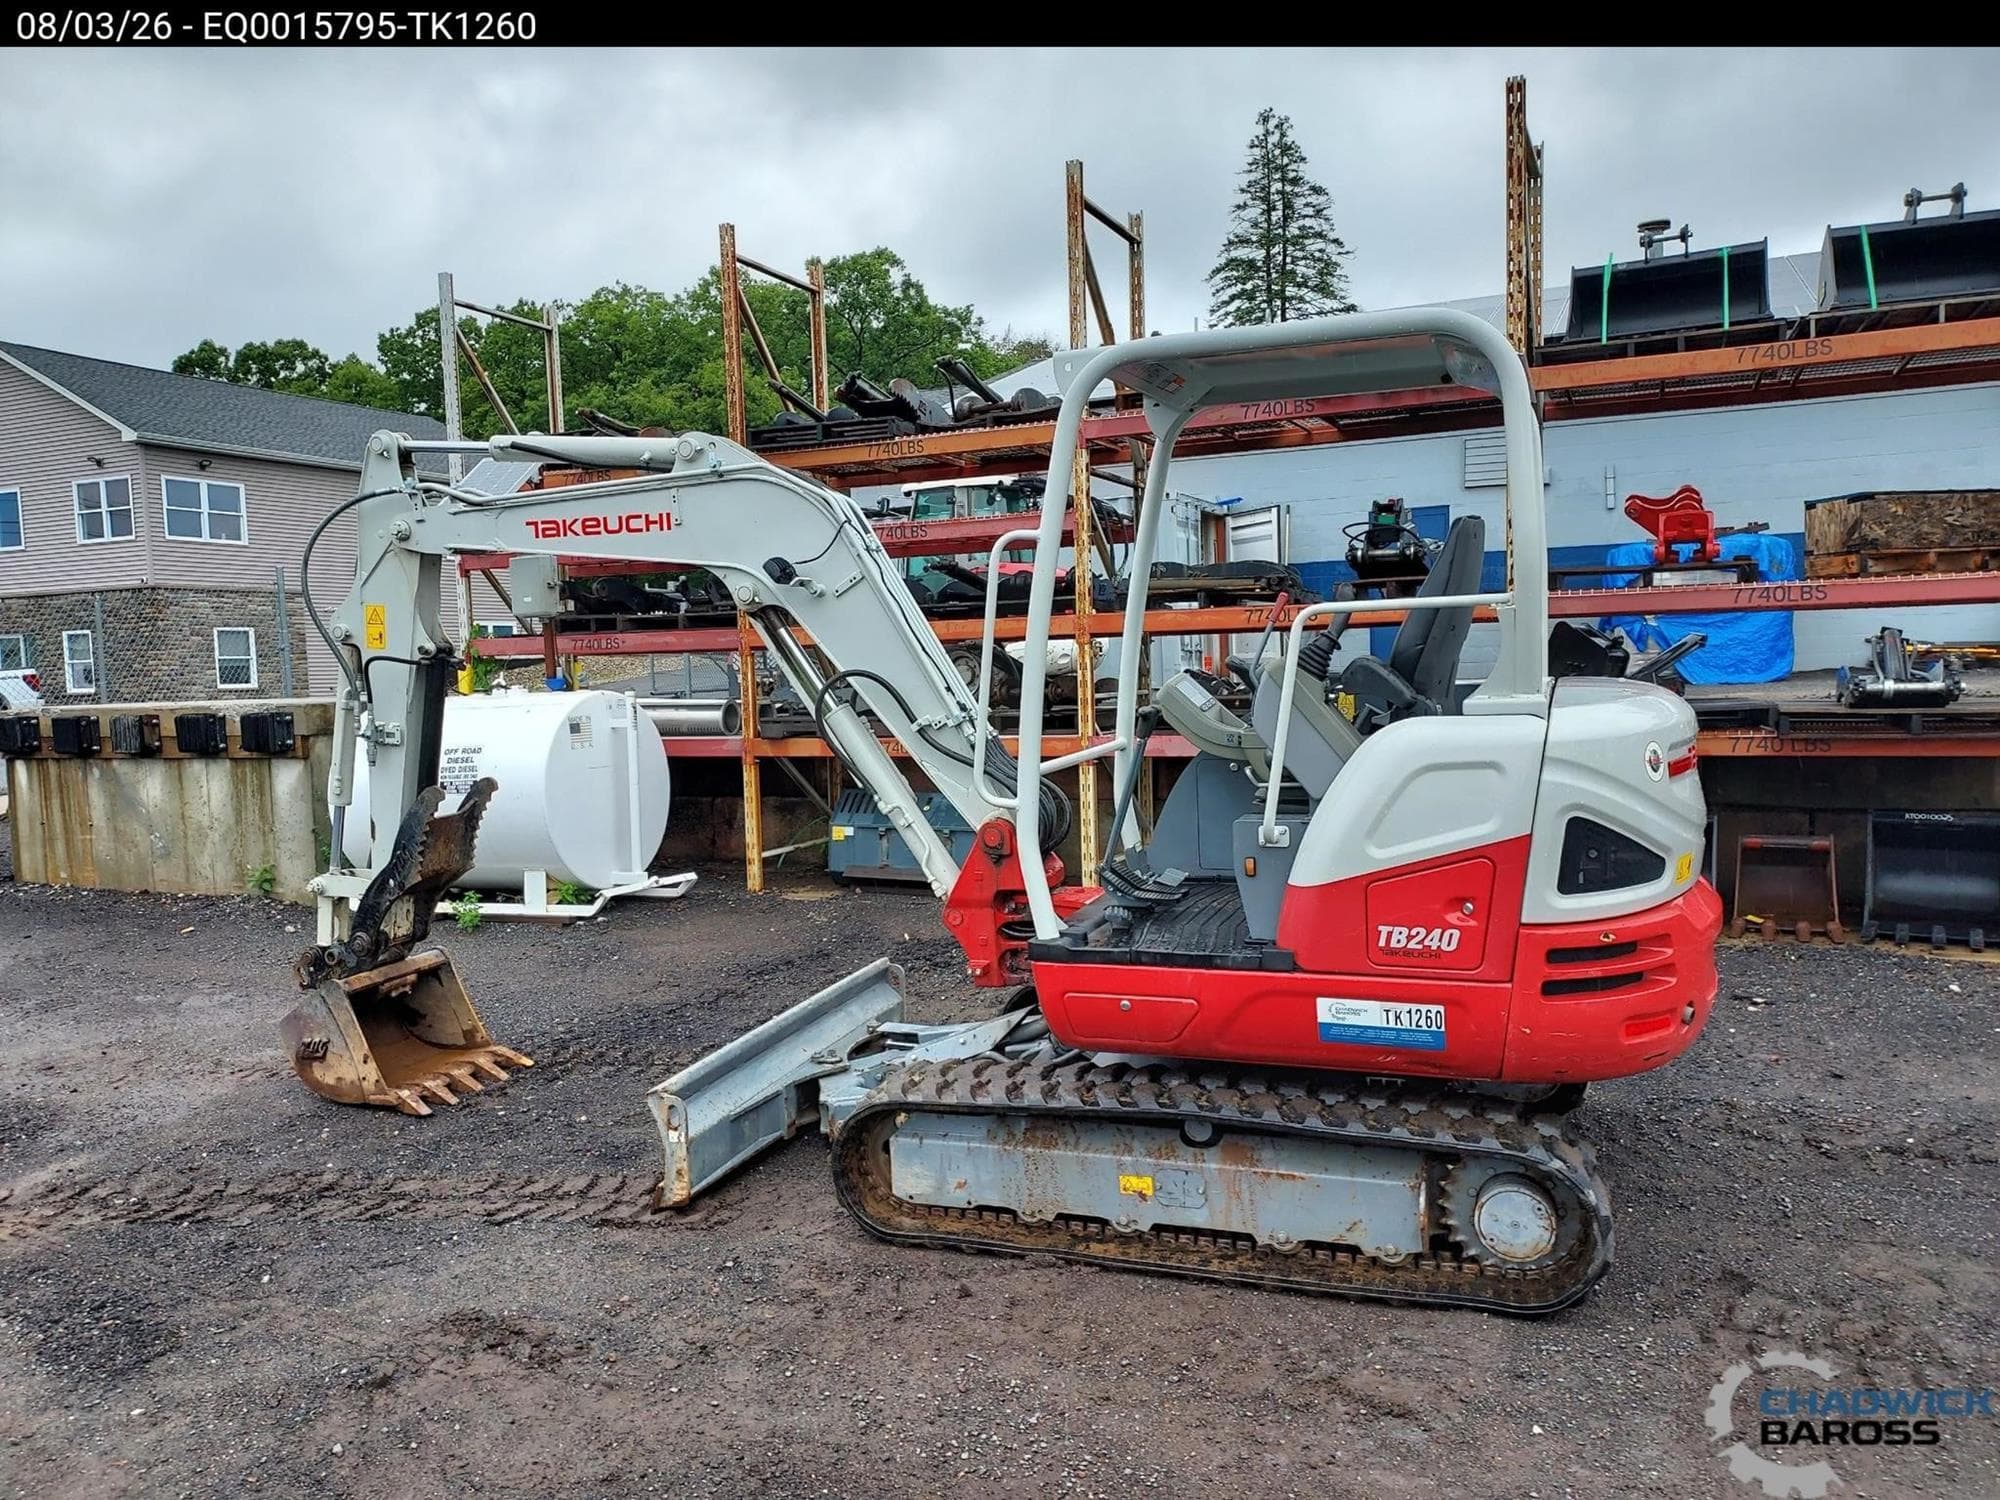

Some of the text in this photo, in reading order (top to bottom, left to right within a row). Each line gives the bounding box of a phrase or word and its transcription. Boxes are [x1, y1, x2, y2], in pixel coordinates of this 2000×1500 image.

[1735, 338, 1833, 364] 7740LBS
[1240, 399, 1317, 420] 7740LBS
[867, 440, 925, 458] 7740LBS
[525, 512, 672, 539] TAKEUCHI
[873, 525, 928, 540] 740LBS
[1733, 585, 1828, 604] 7740LBS
[571, 637, 620, 651] 7740LBS
[444, 747, 482, 756] OFF ROAD
[1727, 737, 1784, 753] 7740
[446, 756, 475, 765] DIESEL
[1377, 925, 1461, 952] TB240
[1383, 1008, 1443, 1030] TK1260
